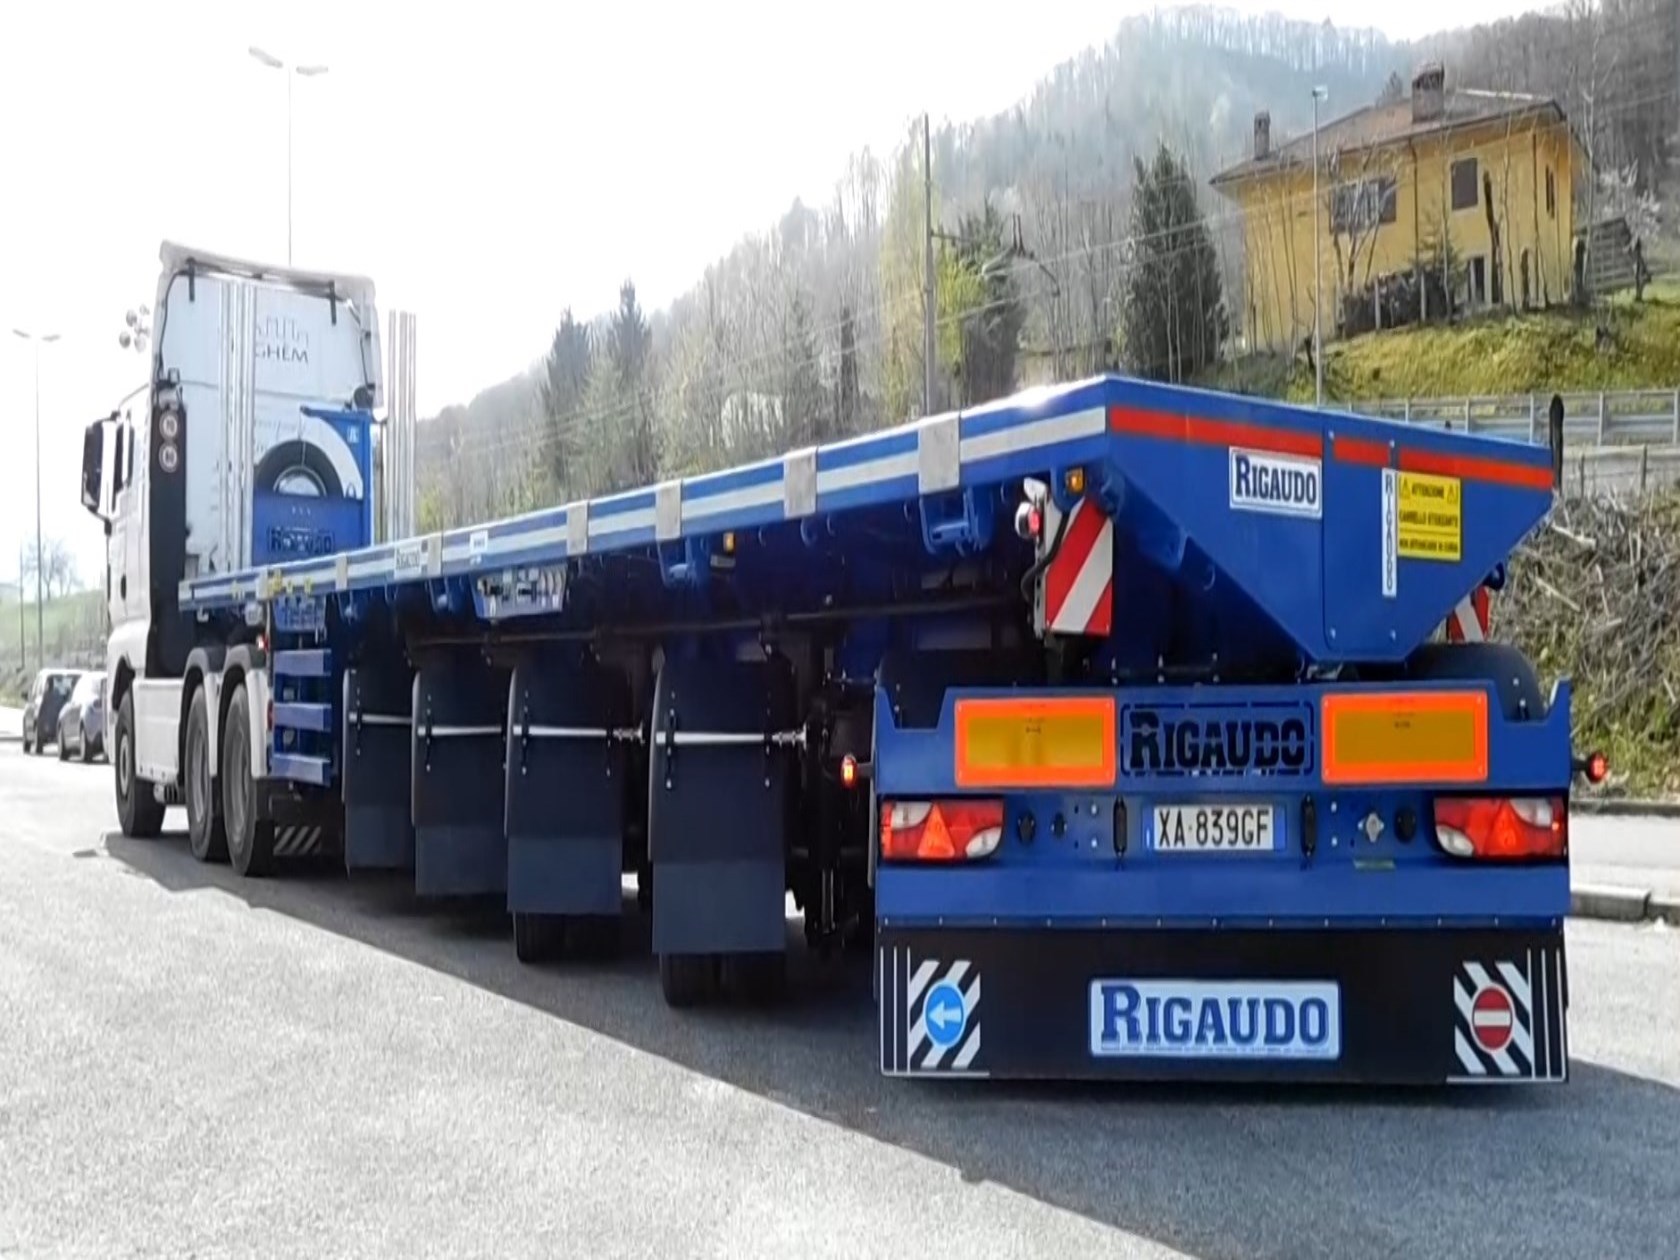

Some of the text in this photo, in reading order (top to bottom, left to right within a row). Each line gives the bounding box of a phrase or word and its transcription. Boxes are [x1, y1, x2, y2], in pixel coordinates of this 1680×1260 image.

[1235, 454, 1317, 505] RIGAUDO
[1385, 473, 1394, 591] RIGAUDO
[1129, 711, 1306, 768] RIGAUDO
[1101, 985, 1329, 1046] RIGAUDO
